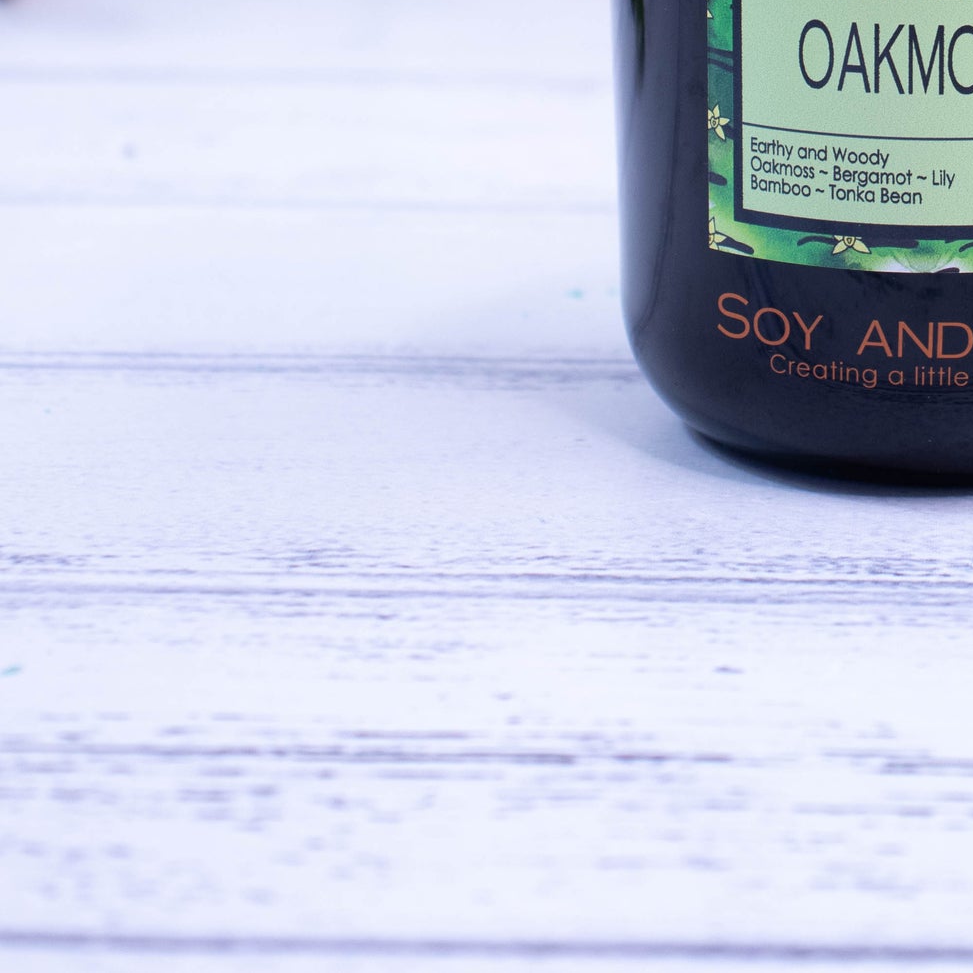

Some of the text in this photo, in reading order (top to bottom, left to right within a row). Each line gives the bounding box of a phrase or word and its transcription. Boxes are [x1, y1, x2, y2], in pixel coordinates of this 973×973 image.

[750, 137, 890, 169] Earthy and Woody
[750, 155, 815, 179] Oakmoss
[833, 166, 912, 188] Bergamot
[932, 169, 956, 189] Lily
[750, 174, 811, 197] Bamboo
[829, 184, 876, 203] Tonka
[880, 188, 923, 205] Bean
[769, 353, 878, 389] Creating
[887, 368, 905, 386] a
[913, 365, 969, 387] little
